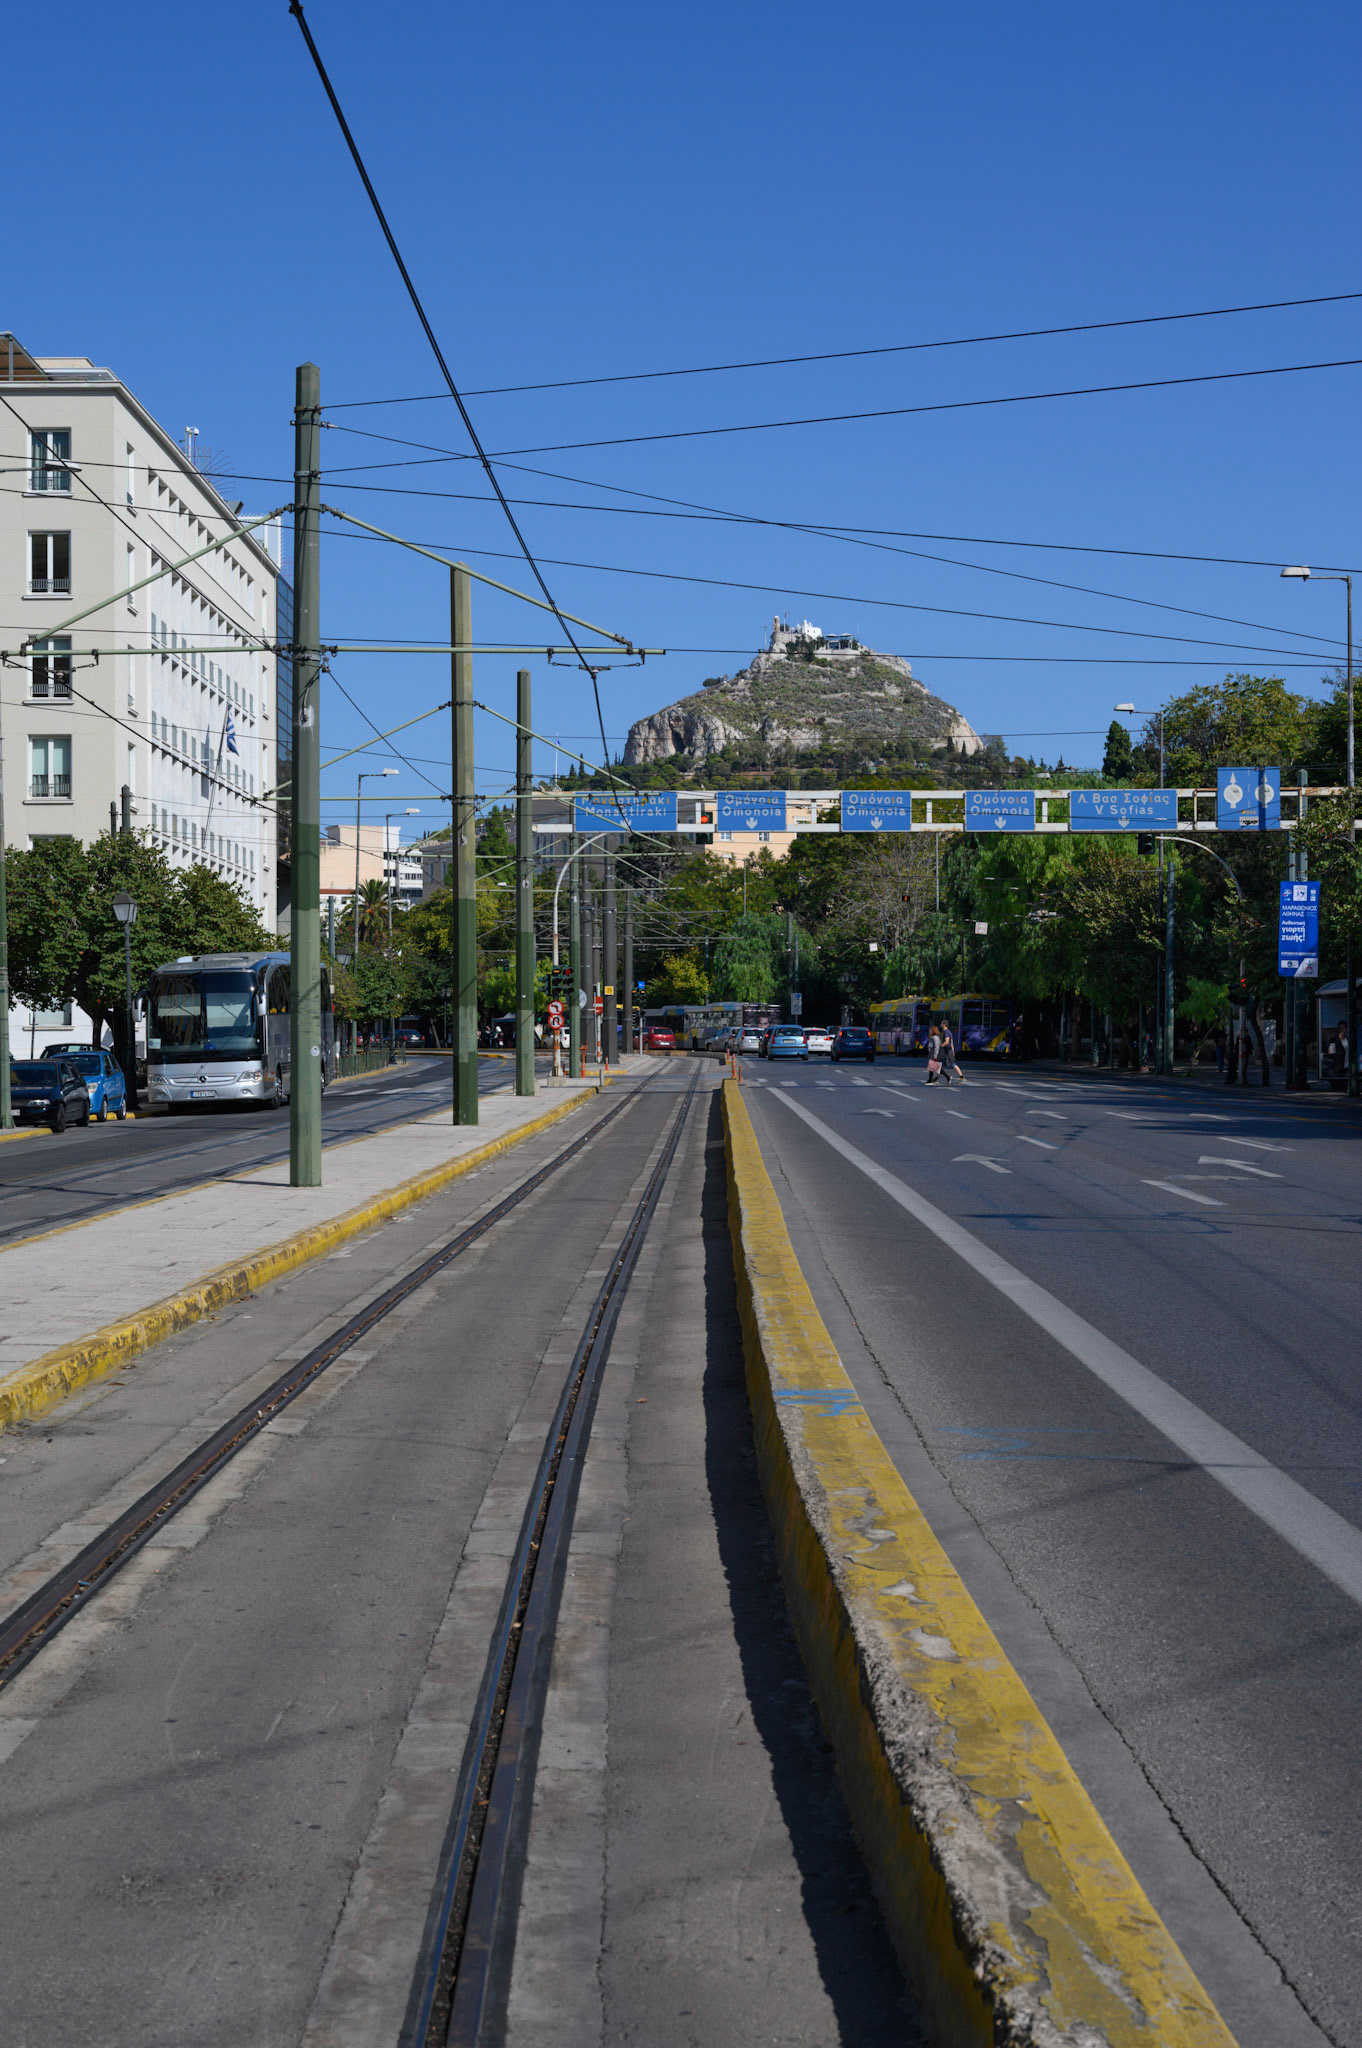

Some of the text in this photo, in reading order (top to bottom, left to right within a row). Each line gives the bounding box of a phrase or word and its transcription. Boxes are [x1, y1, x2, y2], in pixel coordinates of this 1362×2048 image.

[725, 793, 779, 807] Ομόνοια
[849, 793, 904, 807] Ομόνοια
[973, 793, 1028, 807] Ομόνοια
[1124, 791, 1170, 806] Σοφίας
[585, 806, 667, 817] Monastiraki
[722, 805, 782, 817] Omonoia
[847, 805, 906, 817] Omonoia
[971, 805, 1030, 816] Omonoia
[1110, 805, 1154, 815] Sofias
